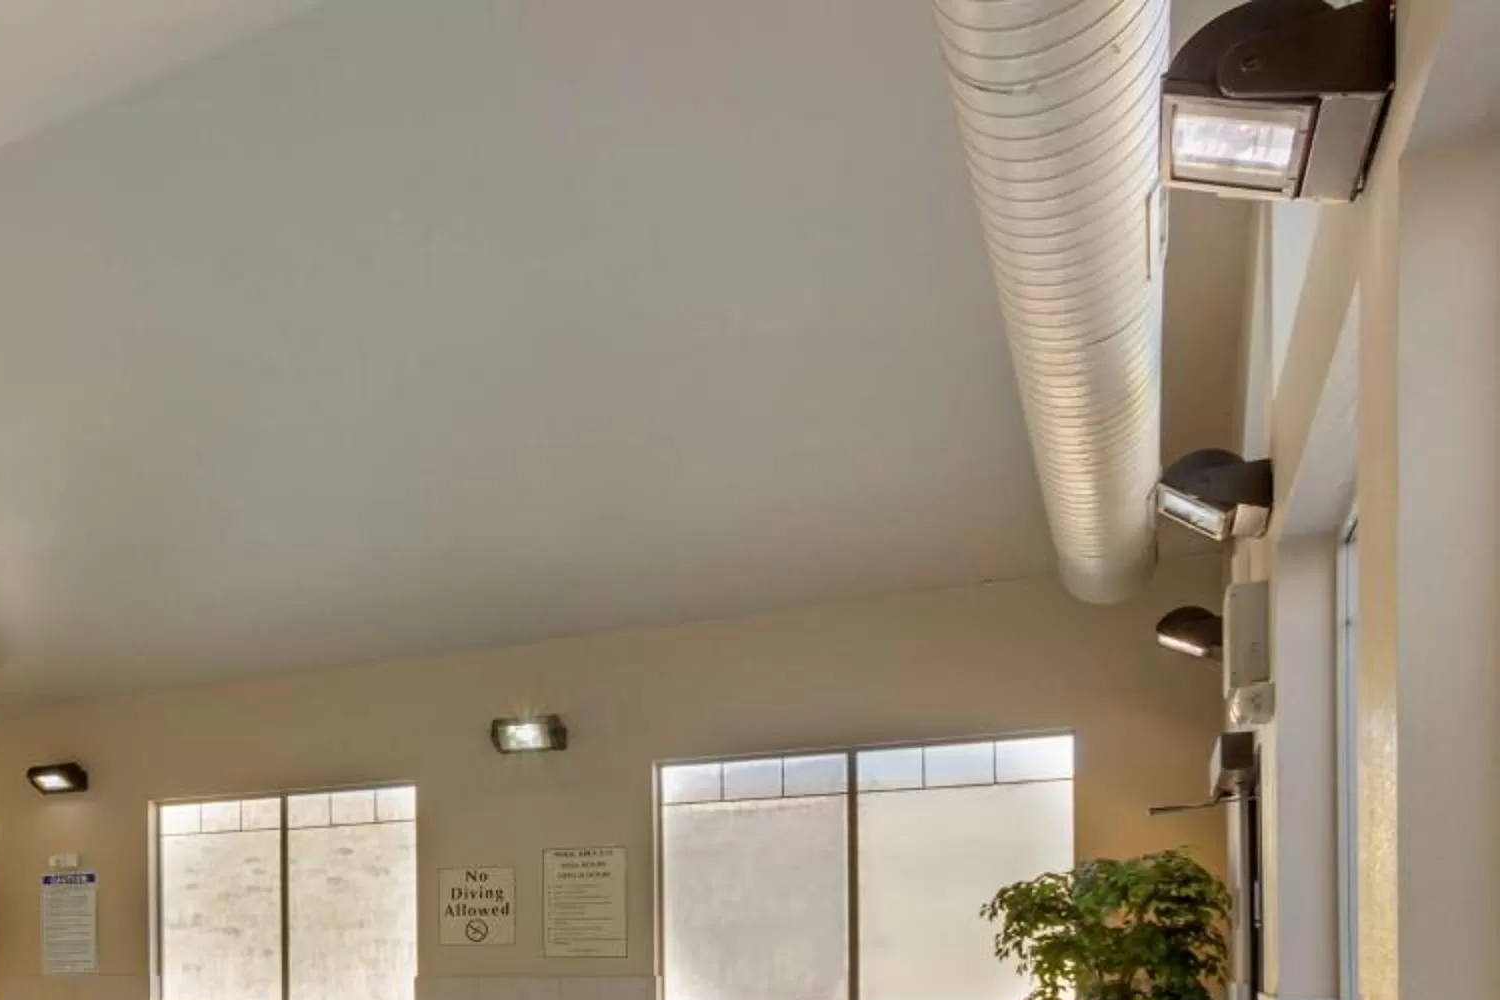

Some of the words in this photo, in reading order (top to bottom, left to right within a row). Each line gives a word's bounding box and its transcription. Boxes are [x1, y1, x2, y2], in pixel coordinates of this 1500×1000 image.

[465, 870, 488, 882] No
[451, 886, 504, 902] Diving
[444, 902, 510, 918] Allowed
